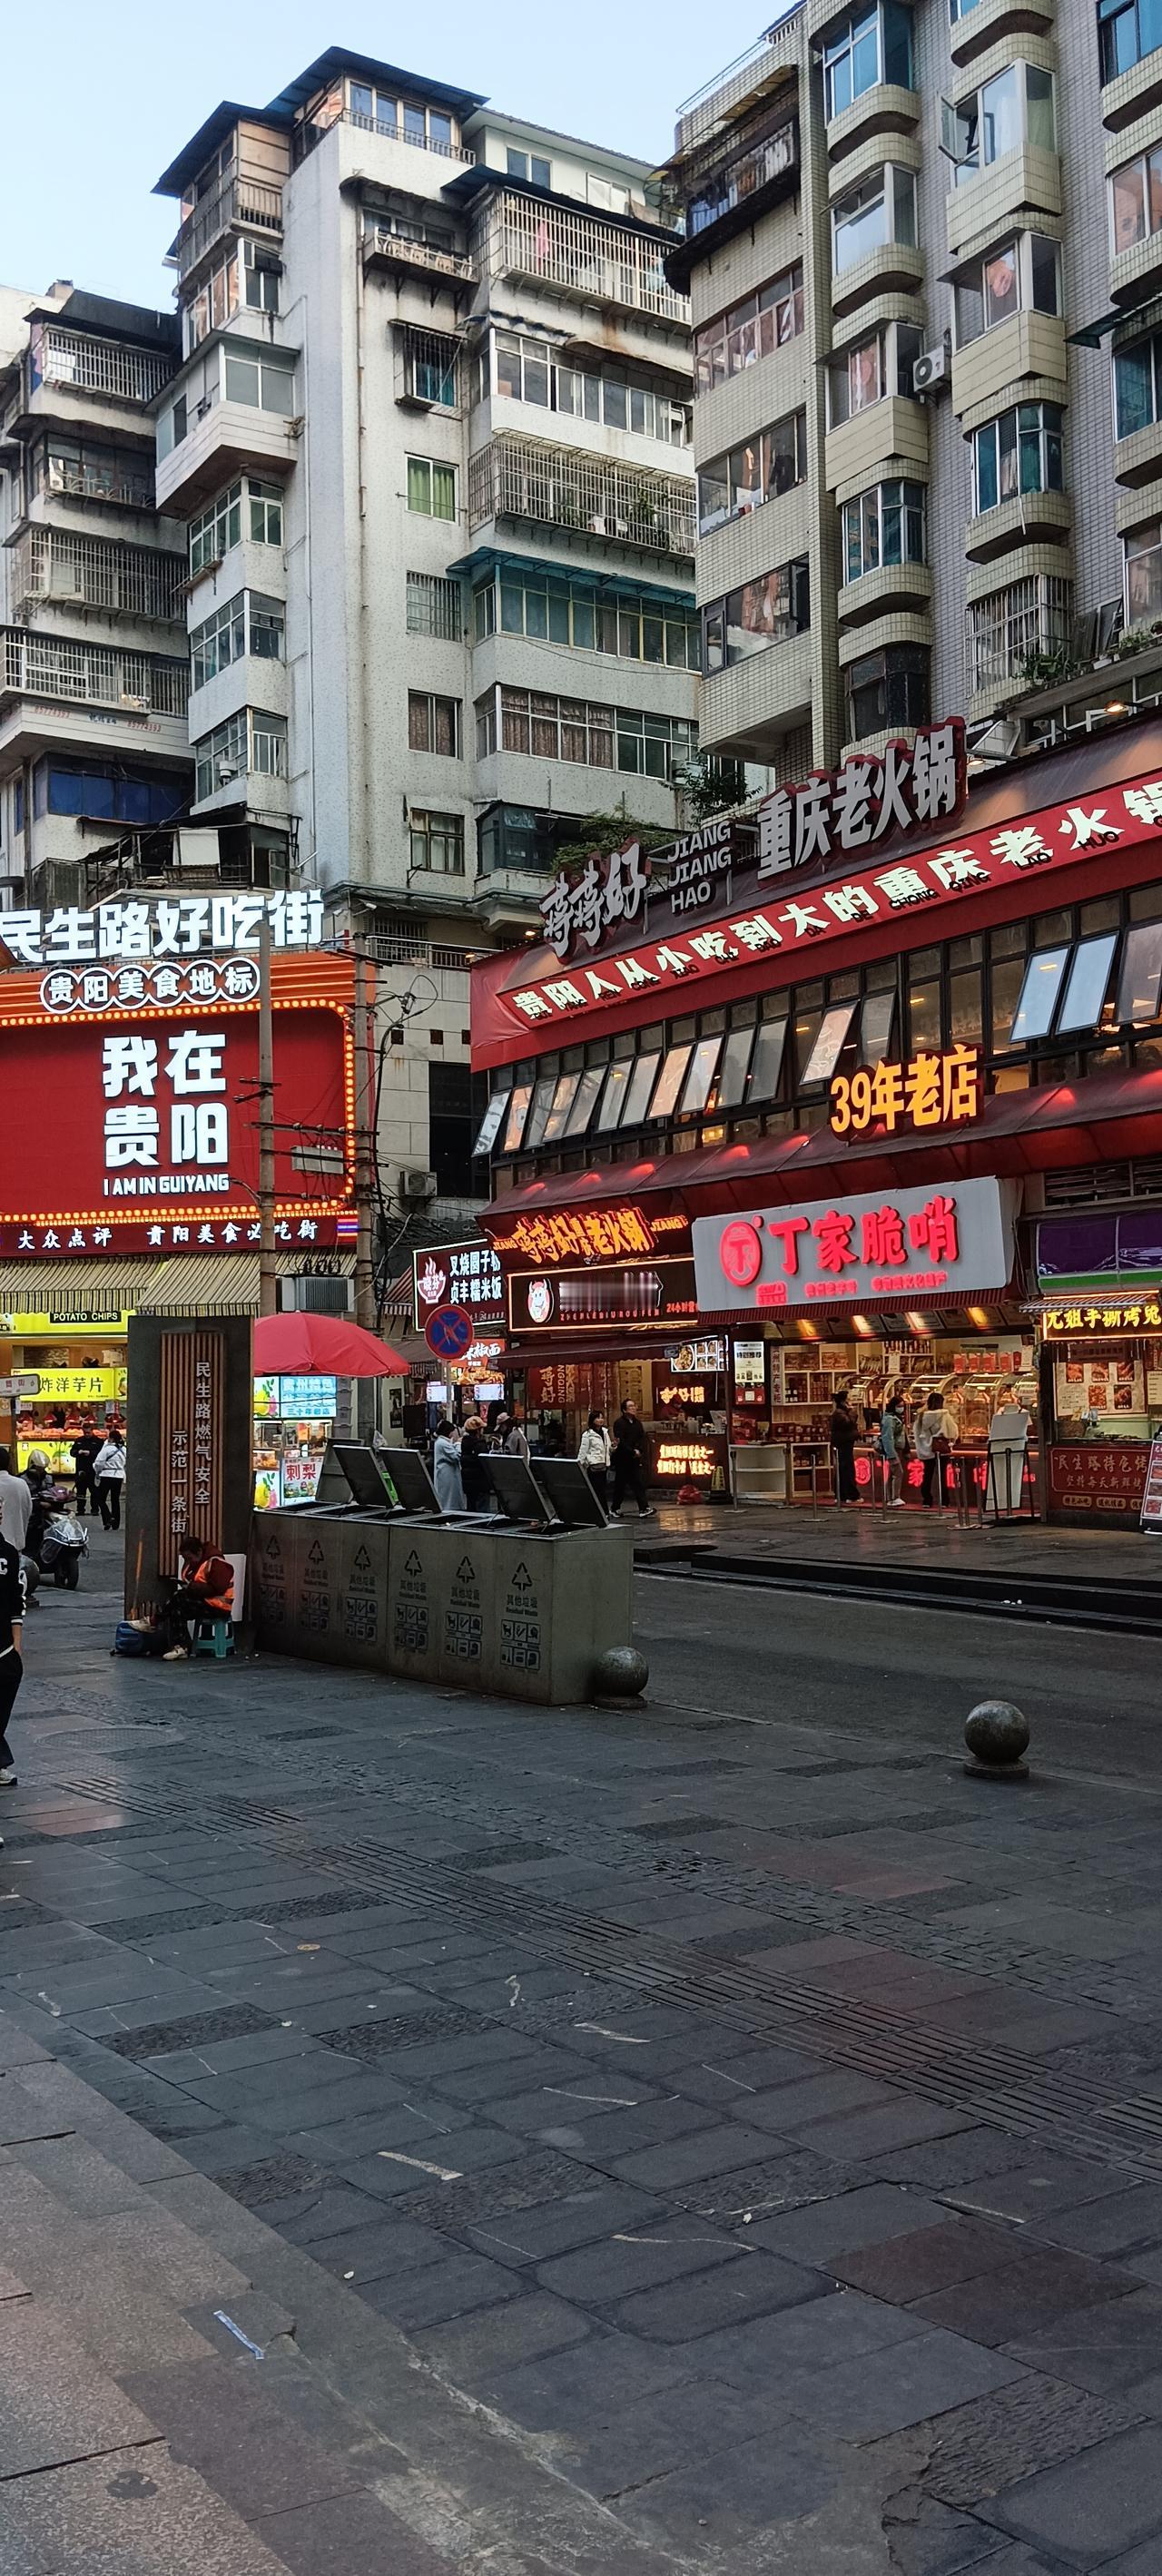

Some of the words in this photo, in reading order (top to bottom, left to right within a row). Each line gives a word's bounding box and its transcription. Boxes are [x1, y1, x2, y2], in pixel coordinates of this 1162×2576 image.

[758, 723, 962, 881] 重庆老火锅
[667, 820, 731, 862] JIANG
[669, 846, 732, 888] JIANG
[949, 871, 991, 893] QING
[1015, 852, 1053, 870] LAO
[1078, 831, 1120, 850] HUO
[513, 781, 1162, 1019] 贵阳人从小吃到大的重庆老火锅
[671, 881, 712, 914] HAO
[0, 890, 325, 962] 民生路好吃街
[49, 966, 255, 1006] 贵阳美食地标
[103, 1030, 226, 1098] 我在
[830, 1044, 979, 1133] 39年老店
[104, 1103, 229, 1167] 贵阳
[103, 1180, 109, 1195] I
[113, 1177, 136, 1195] AM
[140, 1176, 156, 1194] IN
[160, 1174, 230, 1193] GUIYANG
[18, 1227, 113, 1249] 大众点评
[147, 1220, 318, 1247] 贵阳美食必吃街
[769, 1195, 960, 1275] 丁家脆哨
[450, 1276, 502, 1304] 贞丰糯米饭
[666, 1301, 698, 1313] 24小时营
[54, 1313, 88, 1322] POTATO
[92, 1312, 118, 1321] CHIPS
[195, 1362, 212, 1504] 民生路燃气安全
[171, 1431, 188, 1533] 示范一条街
[286, 1463, 316, 1481] 刺梨
